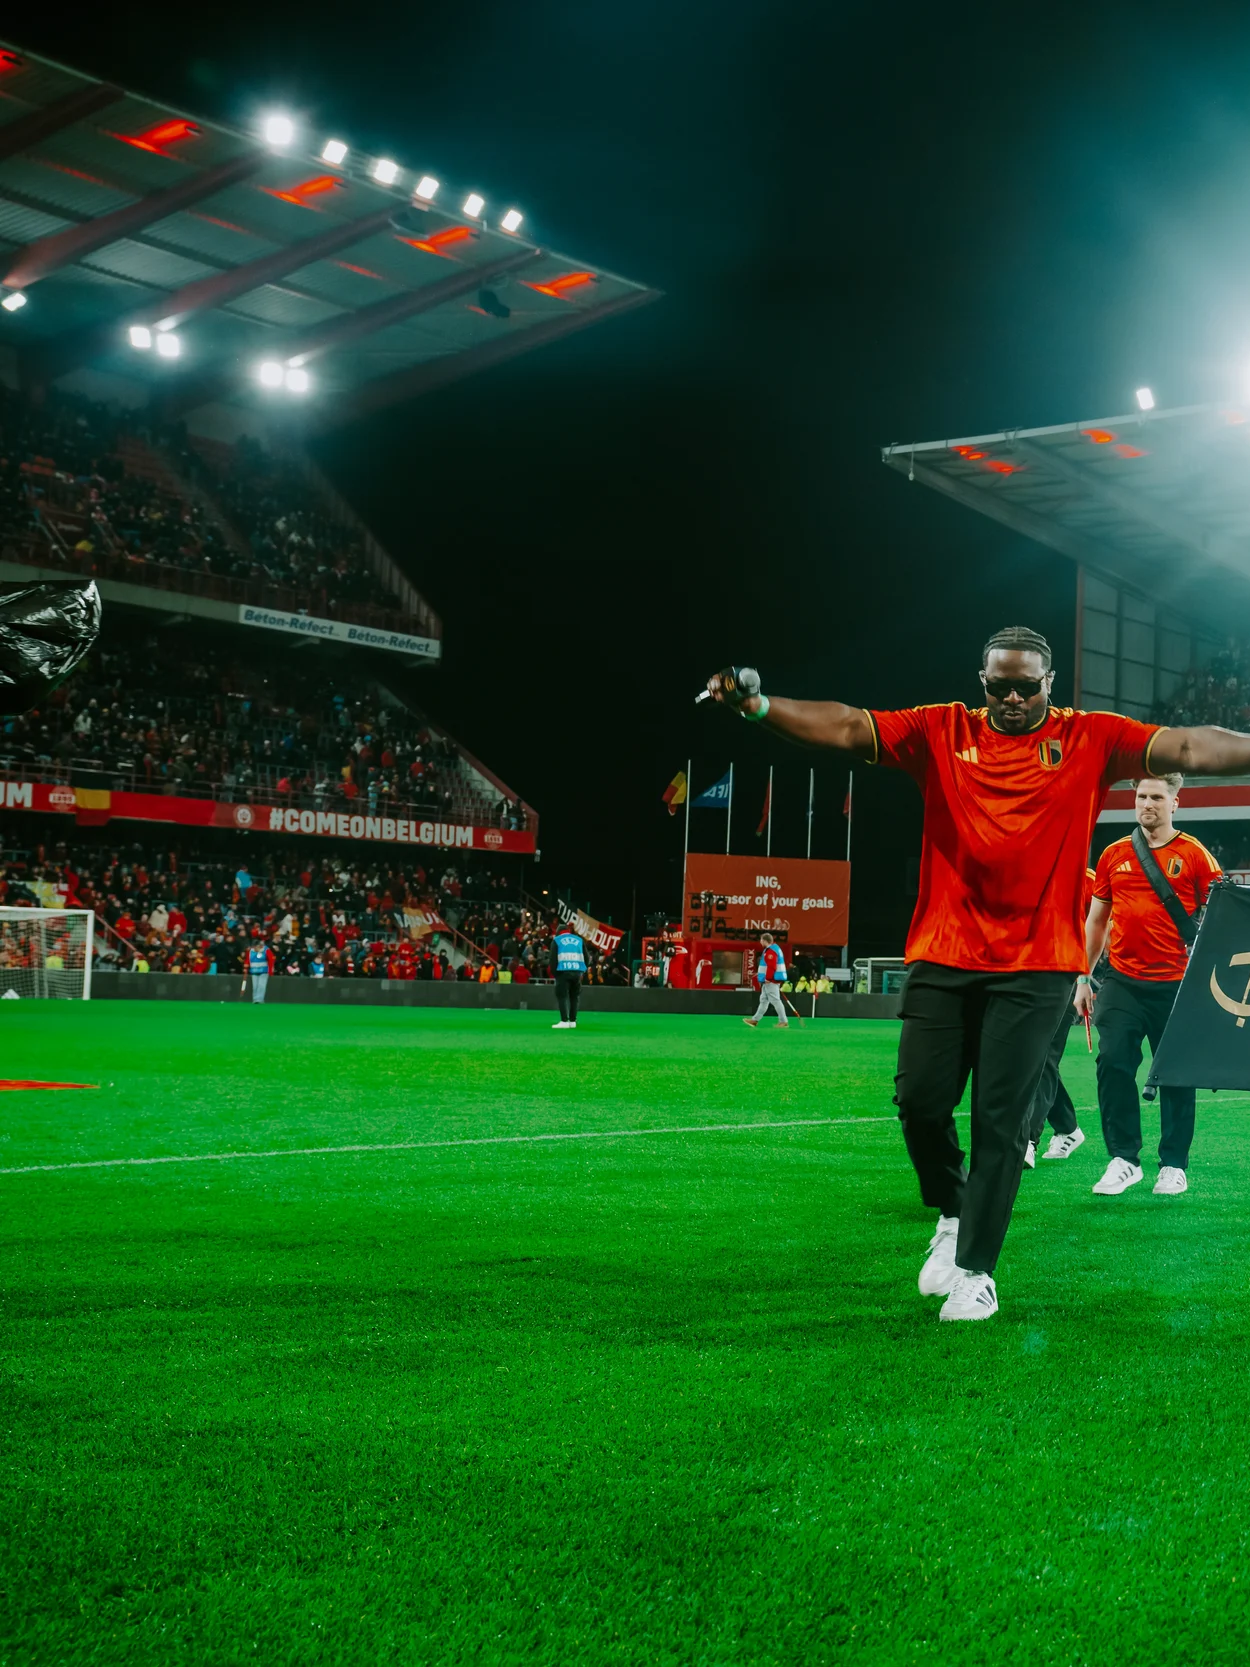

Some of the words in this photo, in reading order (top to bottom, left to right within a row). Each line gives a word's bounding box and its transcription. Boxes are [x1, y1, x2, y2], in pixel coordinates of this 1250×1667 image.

[269, 807, 474, 847] #COMEONBELGIUM
[755, 875, 781, 890] ING,
[755, 893, 769, 906] of
[771, 896, 799, 909] your
[802, 896, 834, 910] goals
[557, 898, 621, 950] TURNHOUT
[744, 919, 771, 931] ING
